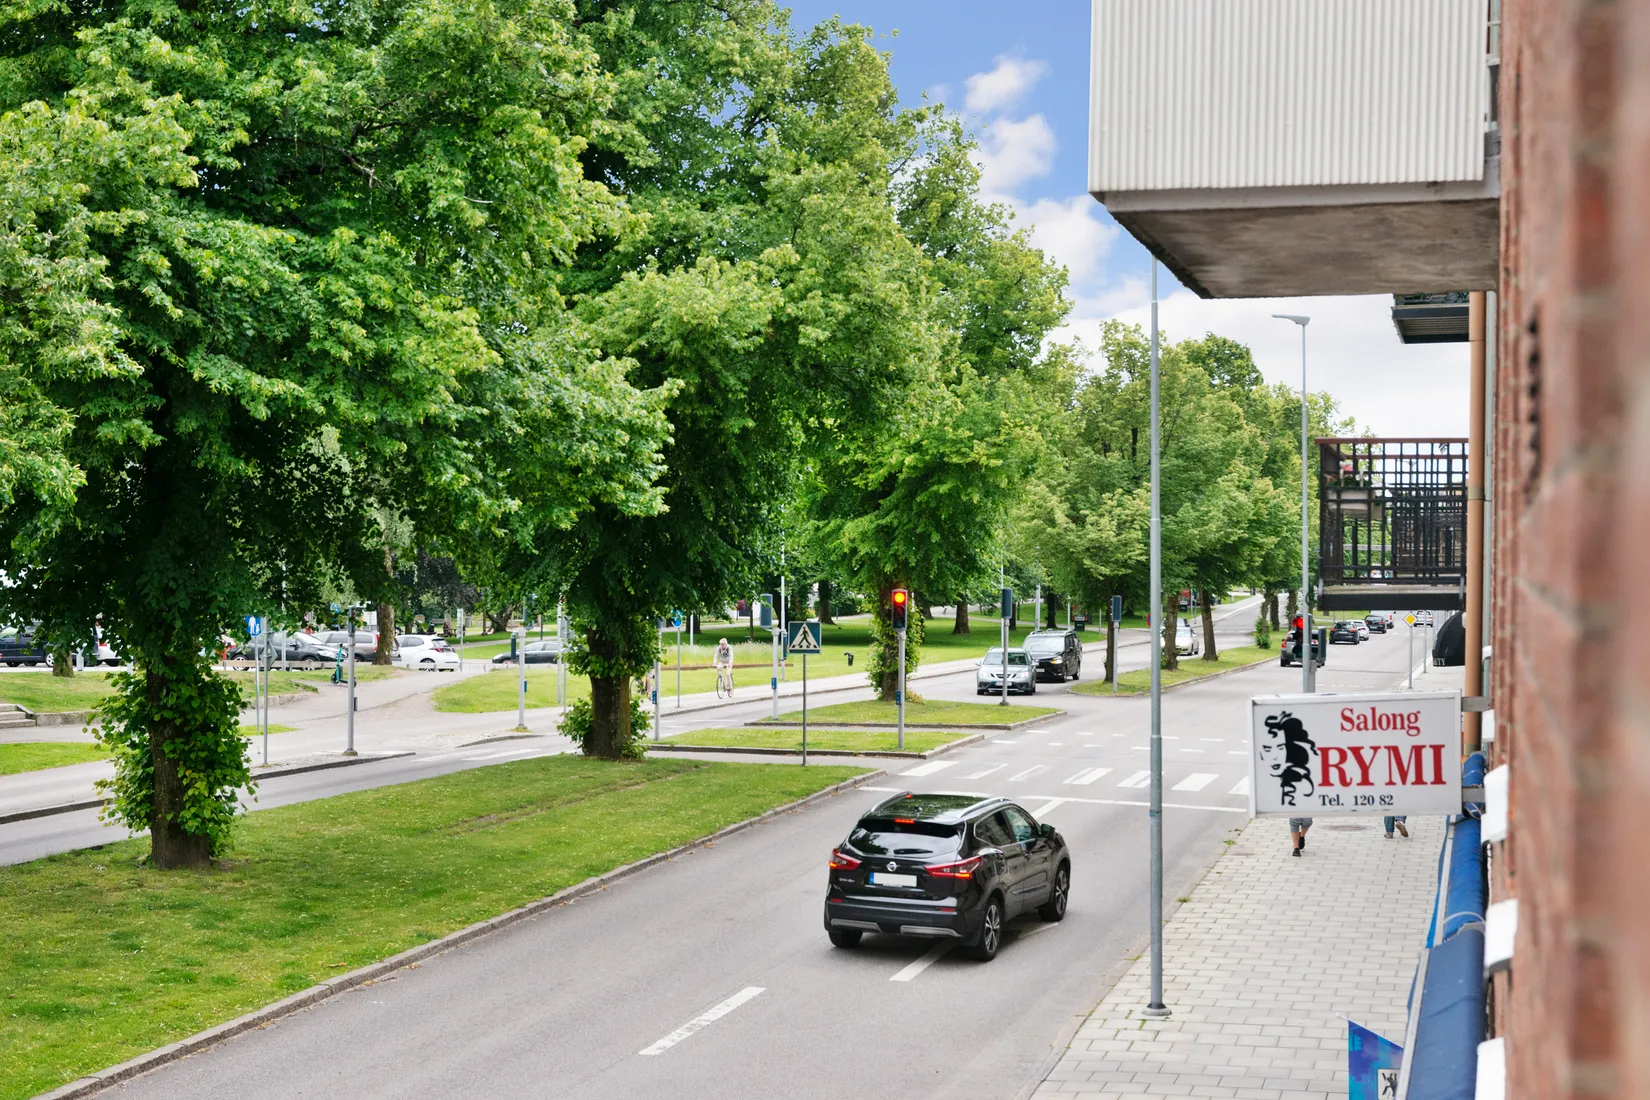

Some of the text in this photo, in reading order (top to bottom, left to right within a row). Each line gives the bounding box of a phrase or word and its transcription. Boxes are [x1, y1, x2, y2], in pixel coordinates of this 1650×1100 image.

[1340, 706, 1421, 737] Salong
[1317, 744, 1447, 787] RYMI
[1318, 794, 1394, 806] Tel. 120 82
